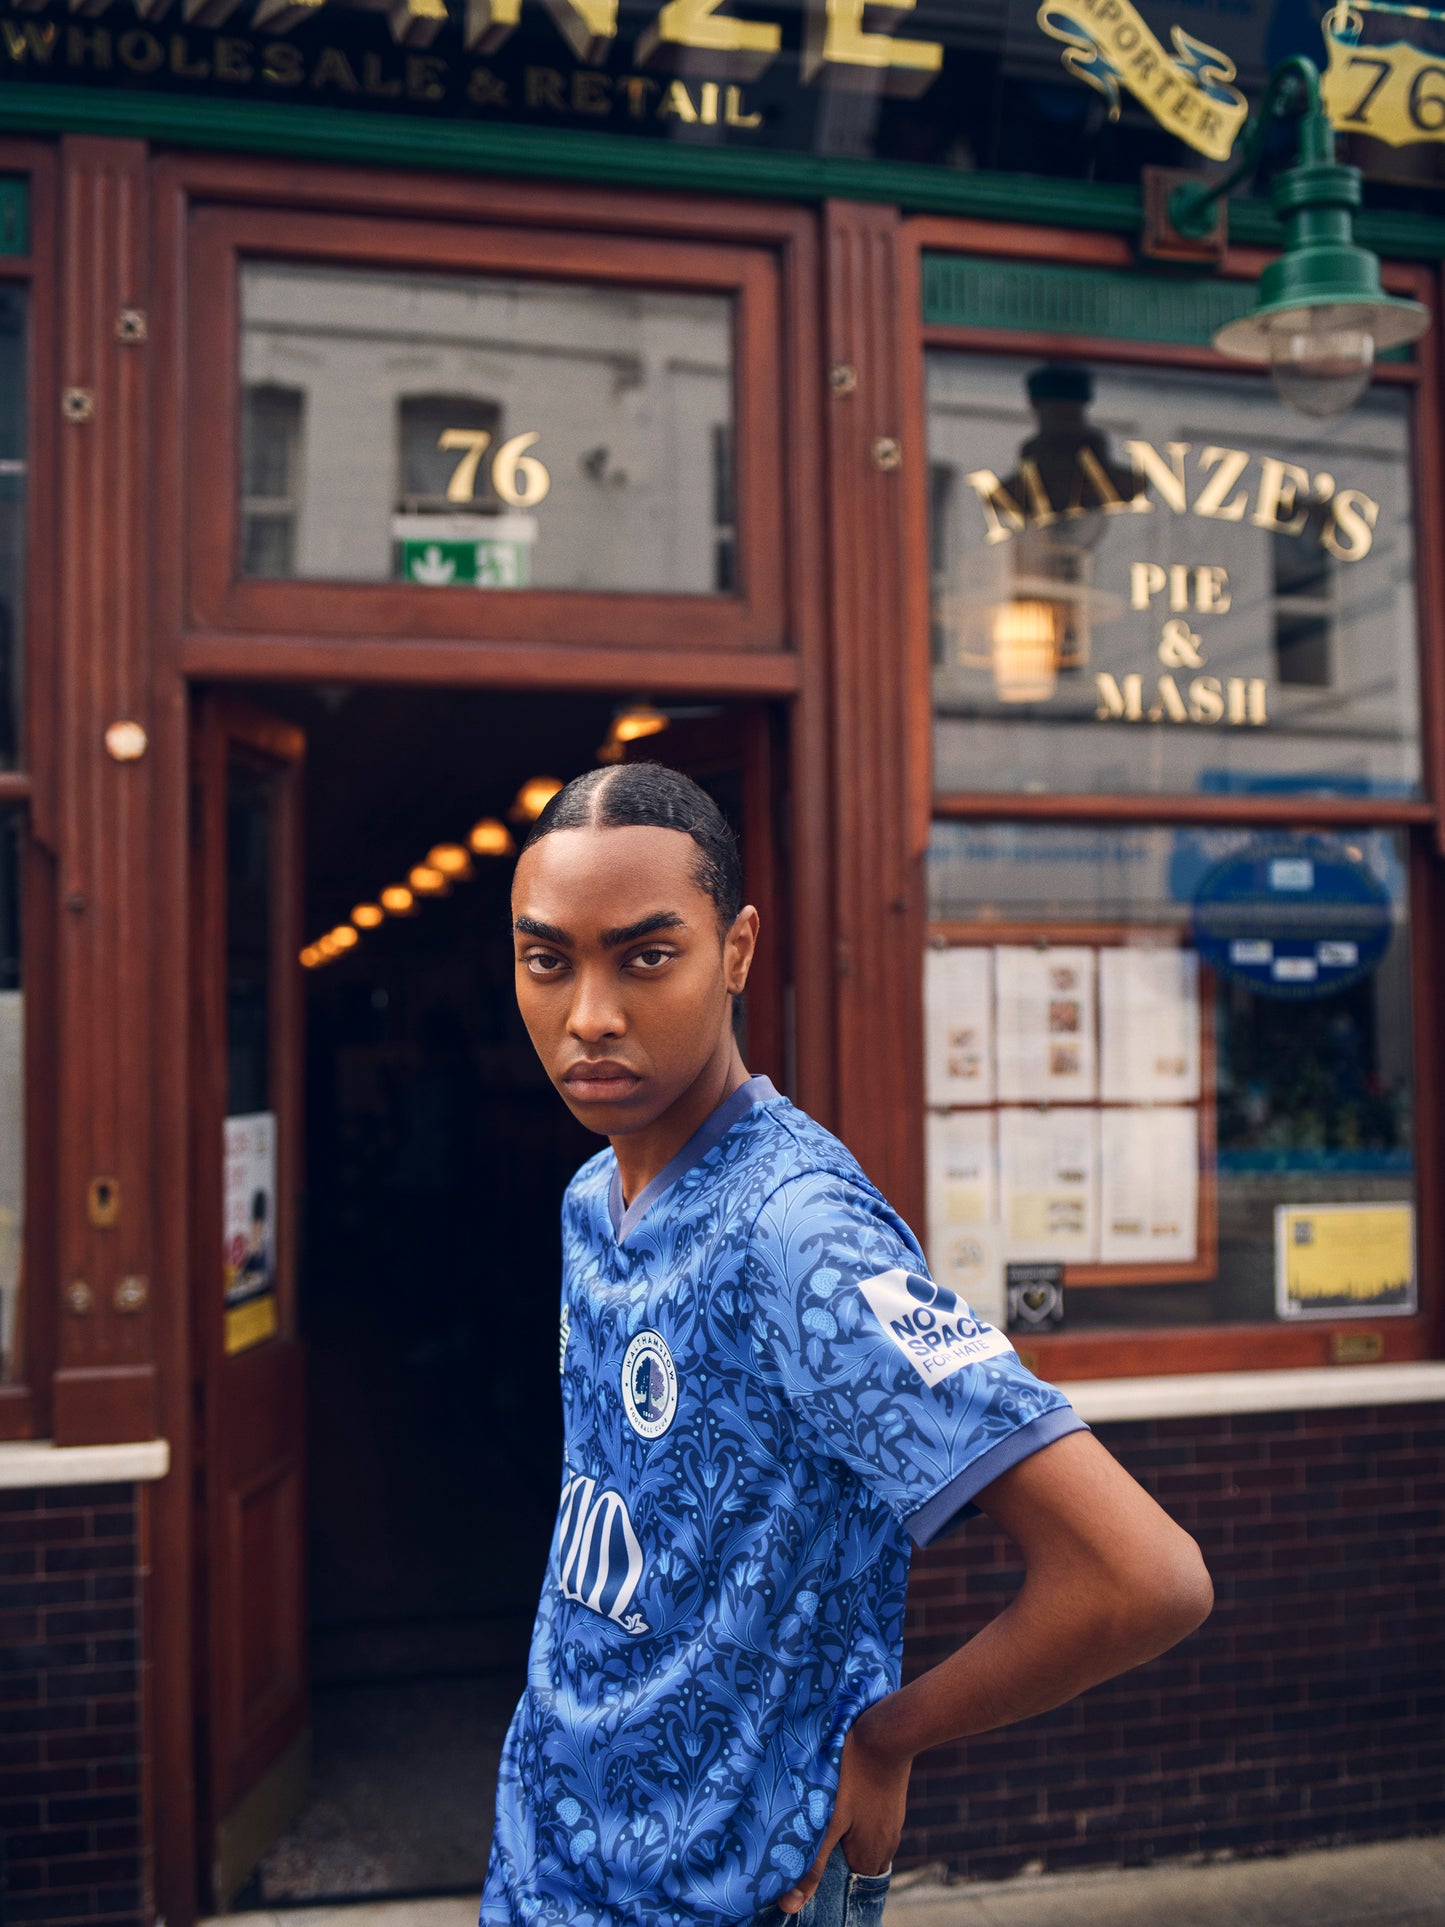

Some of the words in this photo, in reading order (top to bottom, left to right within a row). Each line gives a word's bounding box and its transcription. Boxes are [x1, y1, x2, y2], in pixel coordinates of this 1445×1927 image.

[1, 19, 448, 100] WHOLESALE
[466, 66, 507, 105] &
[524, 66, 763, 128] RETAIL
[1343, 56, 1445, 132] 76
[437, 427, 551, 508] 76
[965, 440, 1380, 562] MANZE'S
[1130, 562, 1232, 614] PIE
[1158, 618, 1206, 669] &
[1094, 671, 1267, 726] MASH
[889, 1306, 936, 1341] NO
[907, 1317, 993, 1357] SPACE
[953, 1339, 990, 1359] HATE
[626, 1335, 674, 1380] WALTHAMSTOW
[629, 1406, 653, 1433] FOOTBALL
[655, 1417, 668, 1432] CLUB
